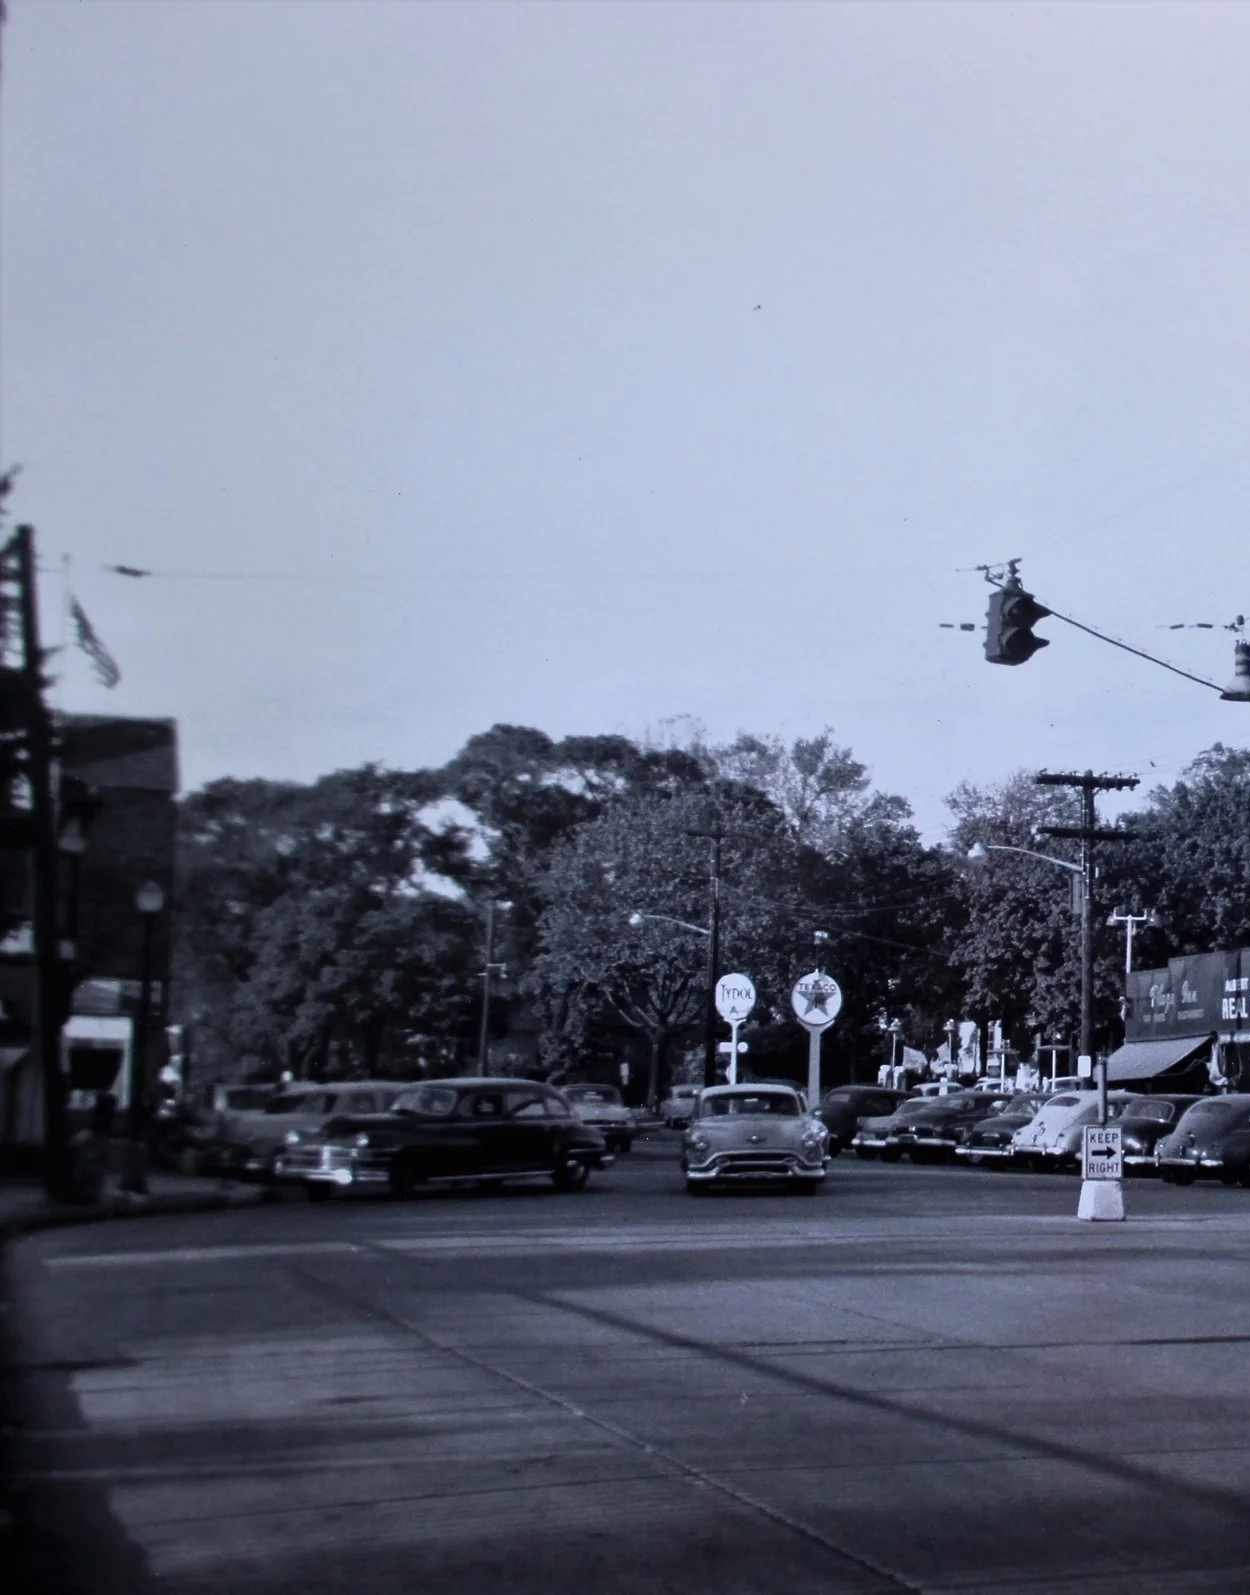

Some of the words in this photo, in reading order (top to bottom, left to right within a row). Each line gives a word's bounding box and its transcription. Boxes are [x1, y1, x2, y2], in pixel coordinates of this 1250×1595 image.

[799, 982, 837, 992] TEXACO
[1222, 997, 1248, 1020] REAL
[1090, 1133, 1118, 1144] KEEP
[1088, 1162, 1119, 1173] RIGHT
